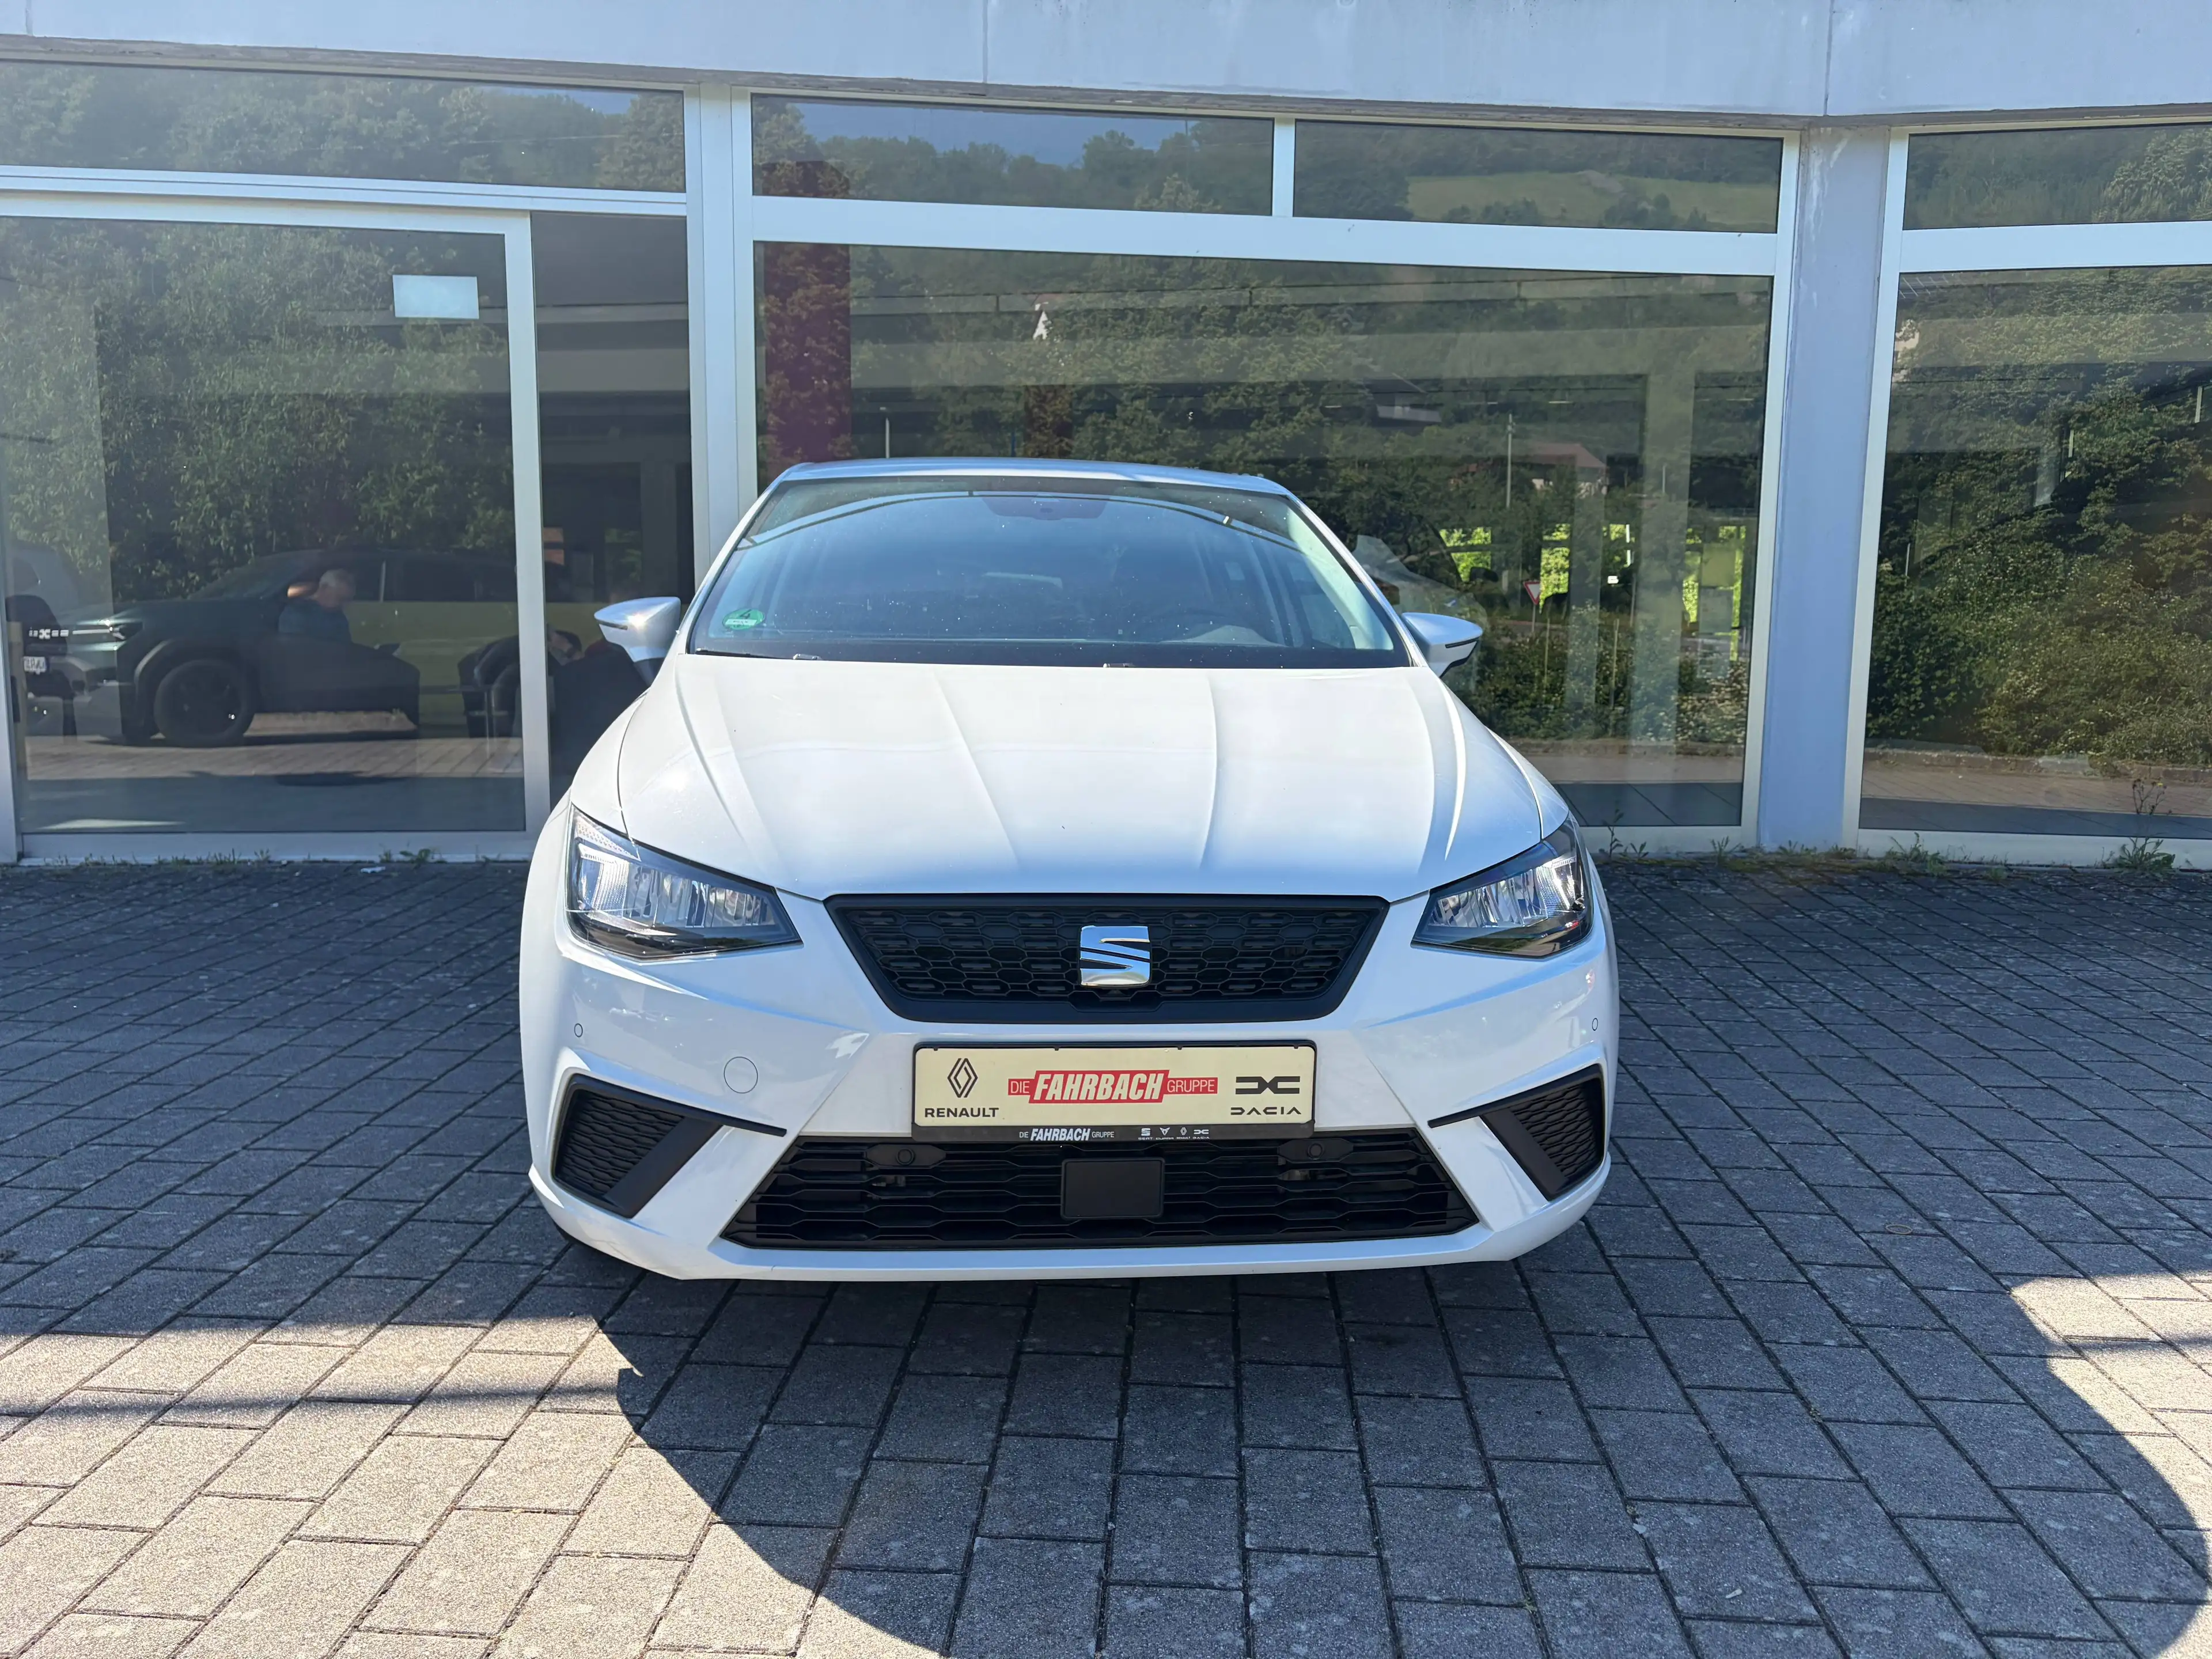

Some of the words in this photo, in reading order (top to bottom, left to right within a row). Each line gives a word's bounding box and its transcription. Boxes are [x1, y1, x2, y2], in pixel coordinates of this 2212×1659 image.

[1010, 1081, 1030, 1093] DIE
[1033, 1073, 1164, 1100] FAHRBACH
[1167, 1079, 1215, 1093] GRUPPE
[924, 1107, 999, 1118] RENAULT
[1230, 1107, 1302, 1115] DACIA
[1030, 1128, 1091, 1141] FAHRBACH
